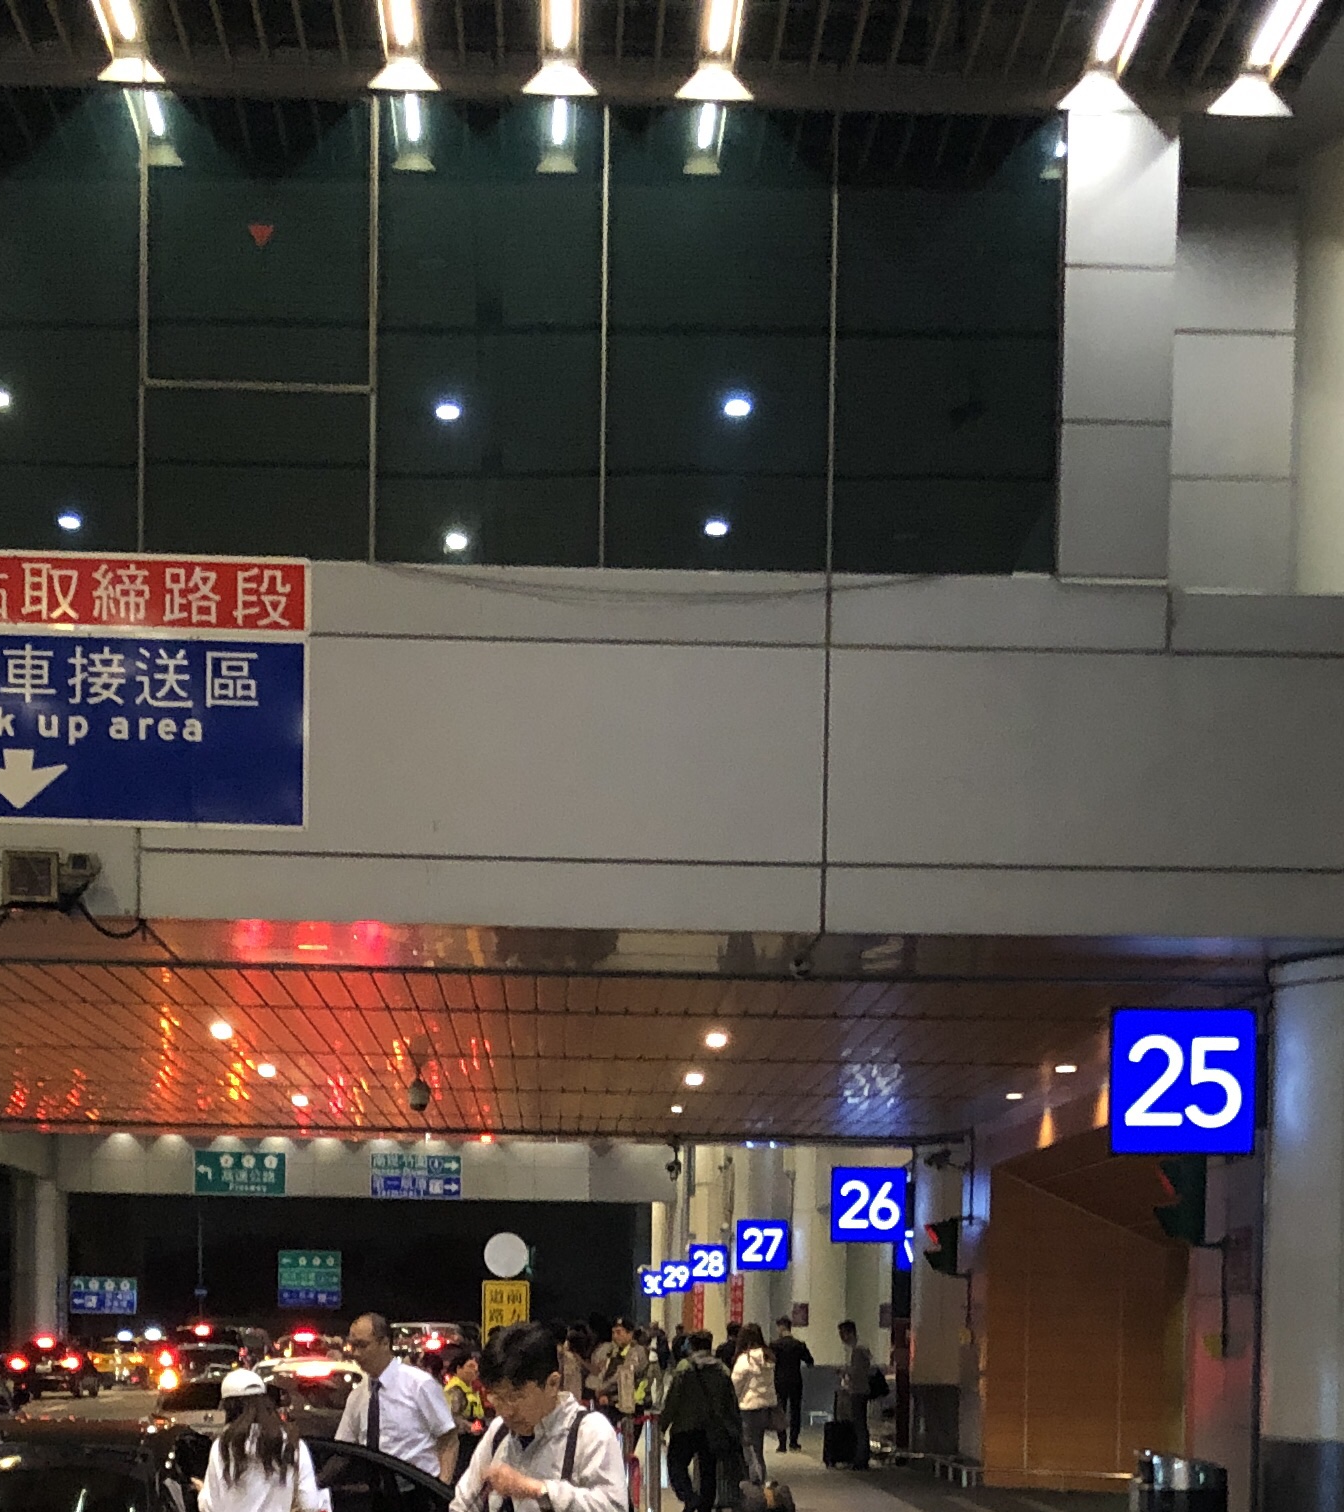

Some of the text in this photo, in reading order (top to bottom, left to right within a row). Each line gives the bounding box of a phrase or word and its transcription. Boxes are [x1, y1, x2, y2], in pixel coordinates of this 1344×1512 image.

[37, 713, 89, 746] up
[109, 714, 203, 742] area
[1124, 1034, 1243, 1129] 25
[838, 1180, 901, 1230] 26
[742, 1227, 784, 1263] 27
[663, 1265, 690, 1288] 29
[693, 1250, 725, 1278] 28
